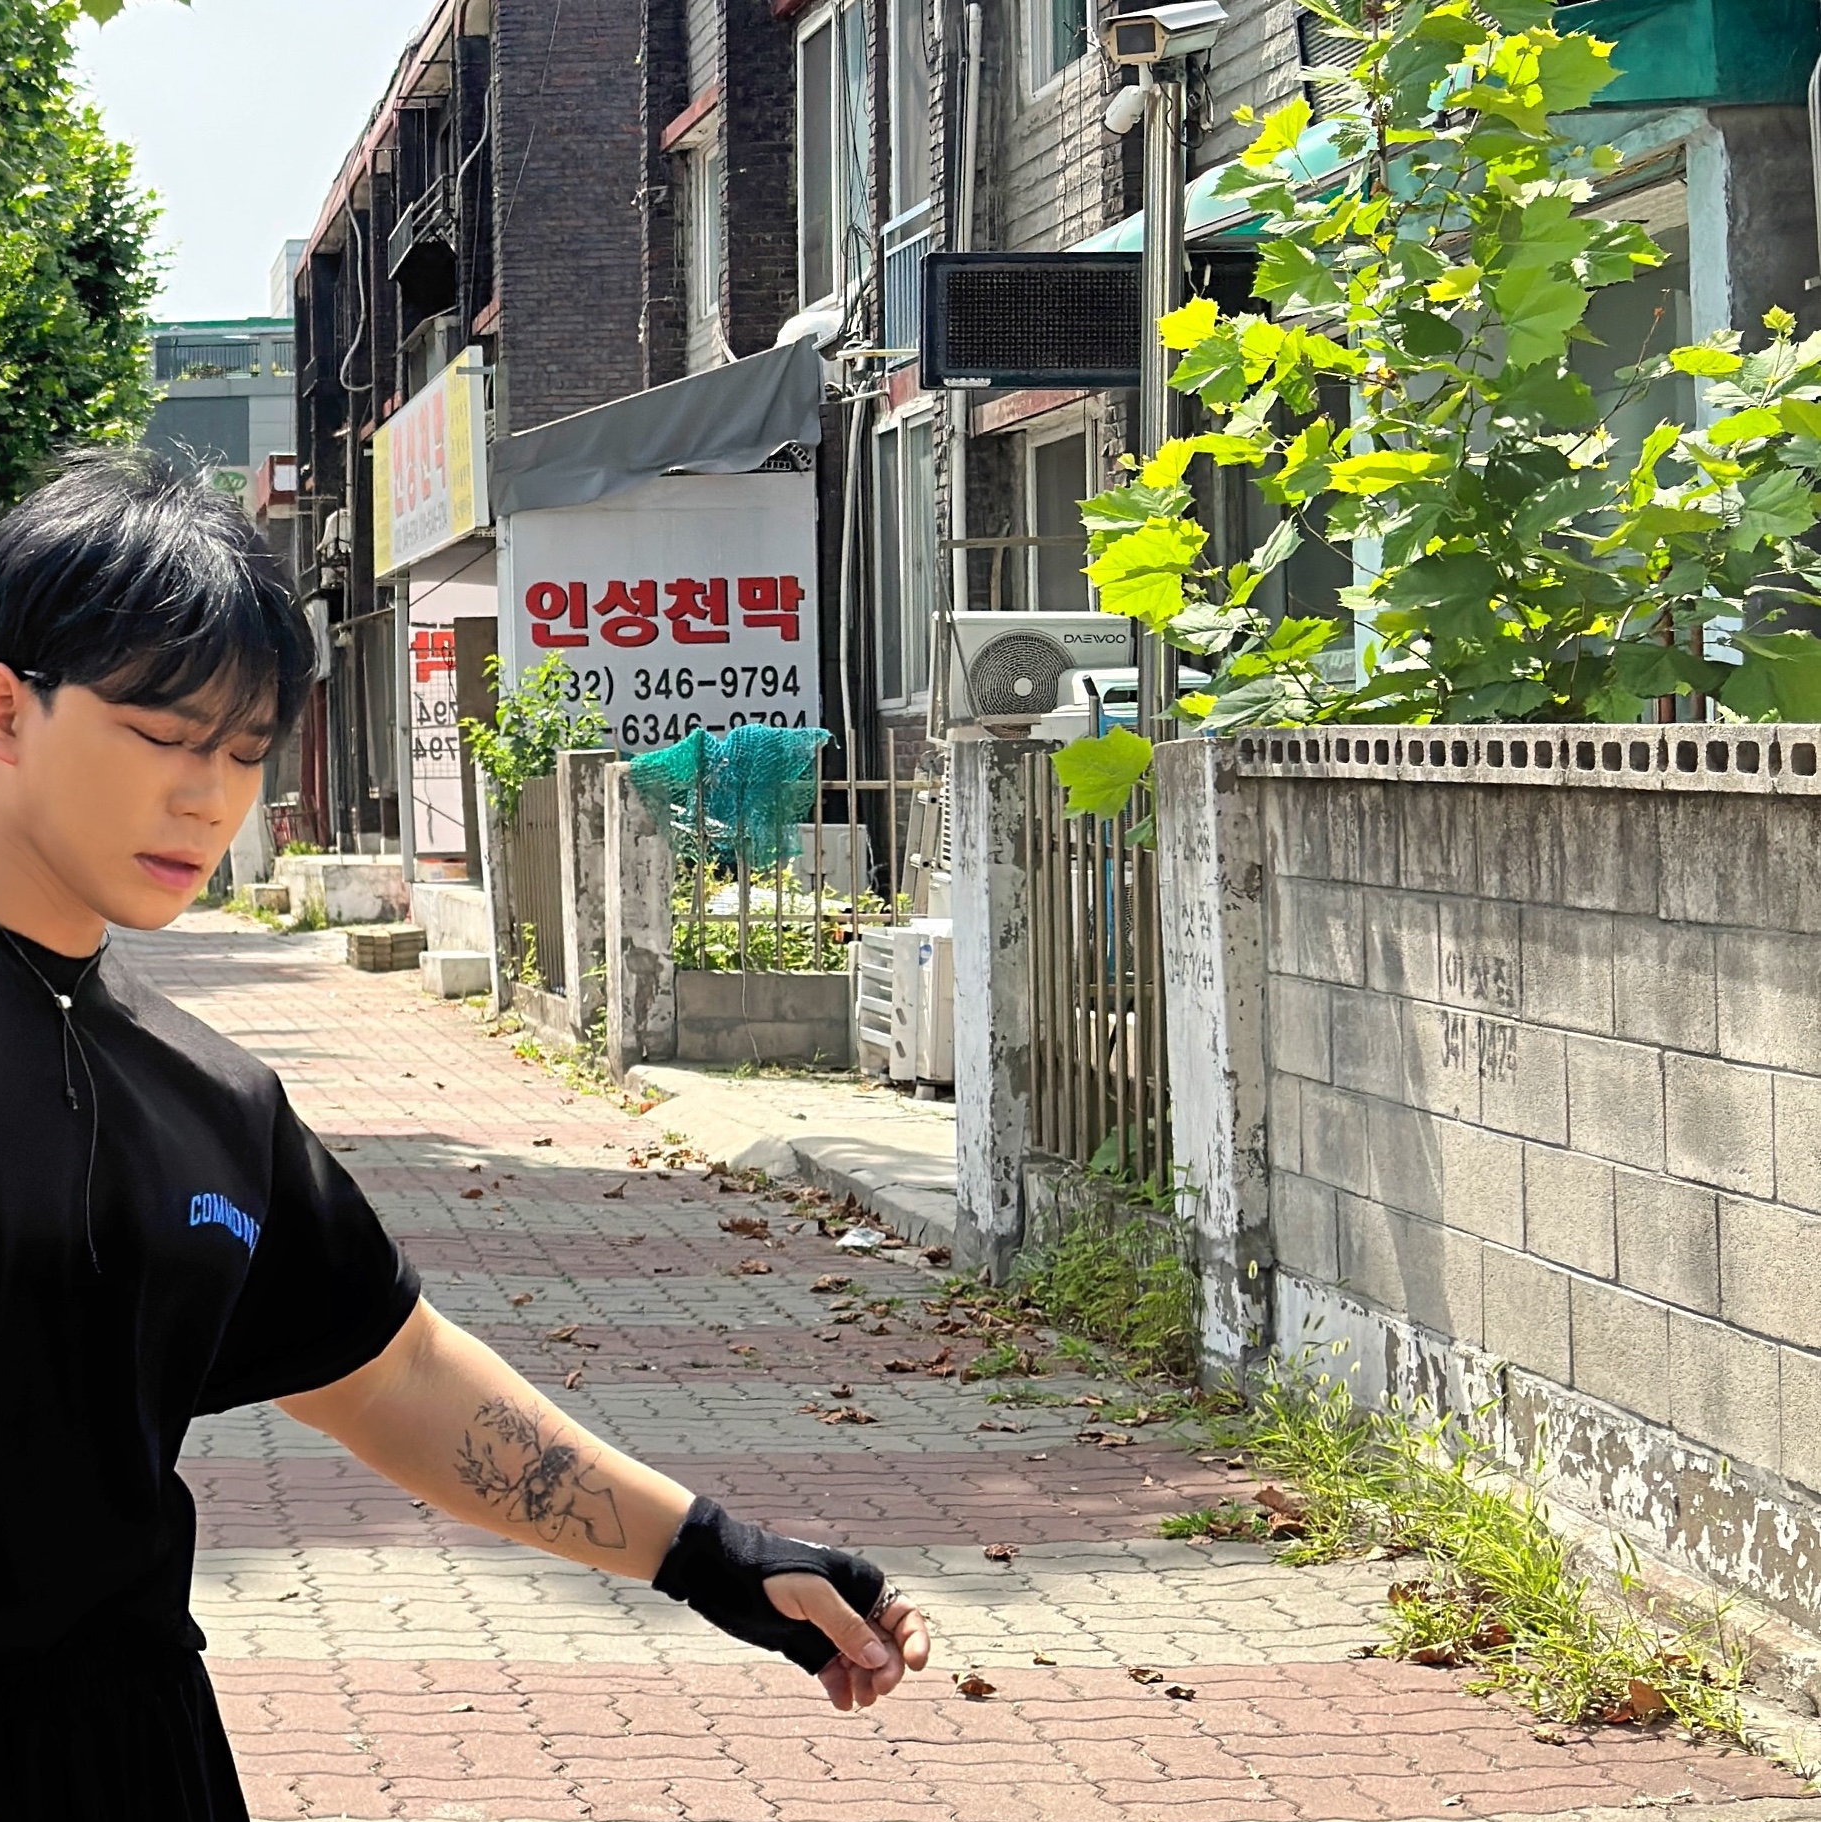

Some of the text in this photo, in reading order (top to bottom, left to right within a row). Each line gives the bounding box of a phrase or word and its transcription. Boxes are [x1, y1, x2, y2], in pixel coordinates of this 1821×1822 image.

[525, 575, 805, 648] 인성천막
[1064, 634, 1126, 643] DAEWOO
[634, 664, 801, 701] 346-9794
